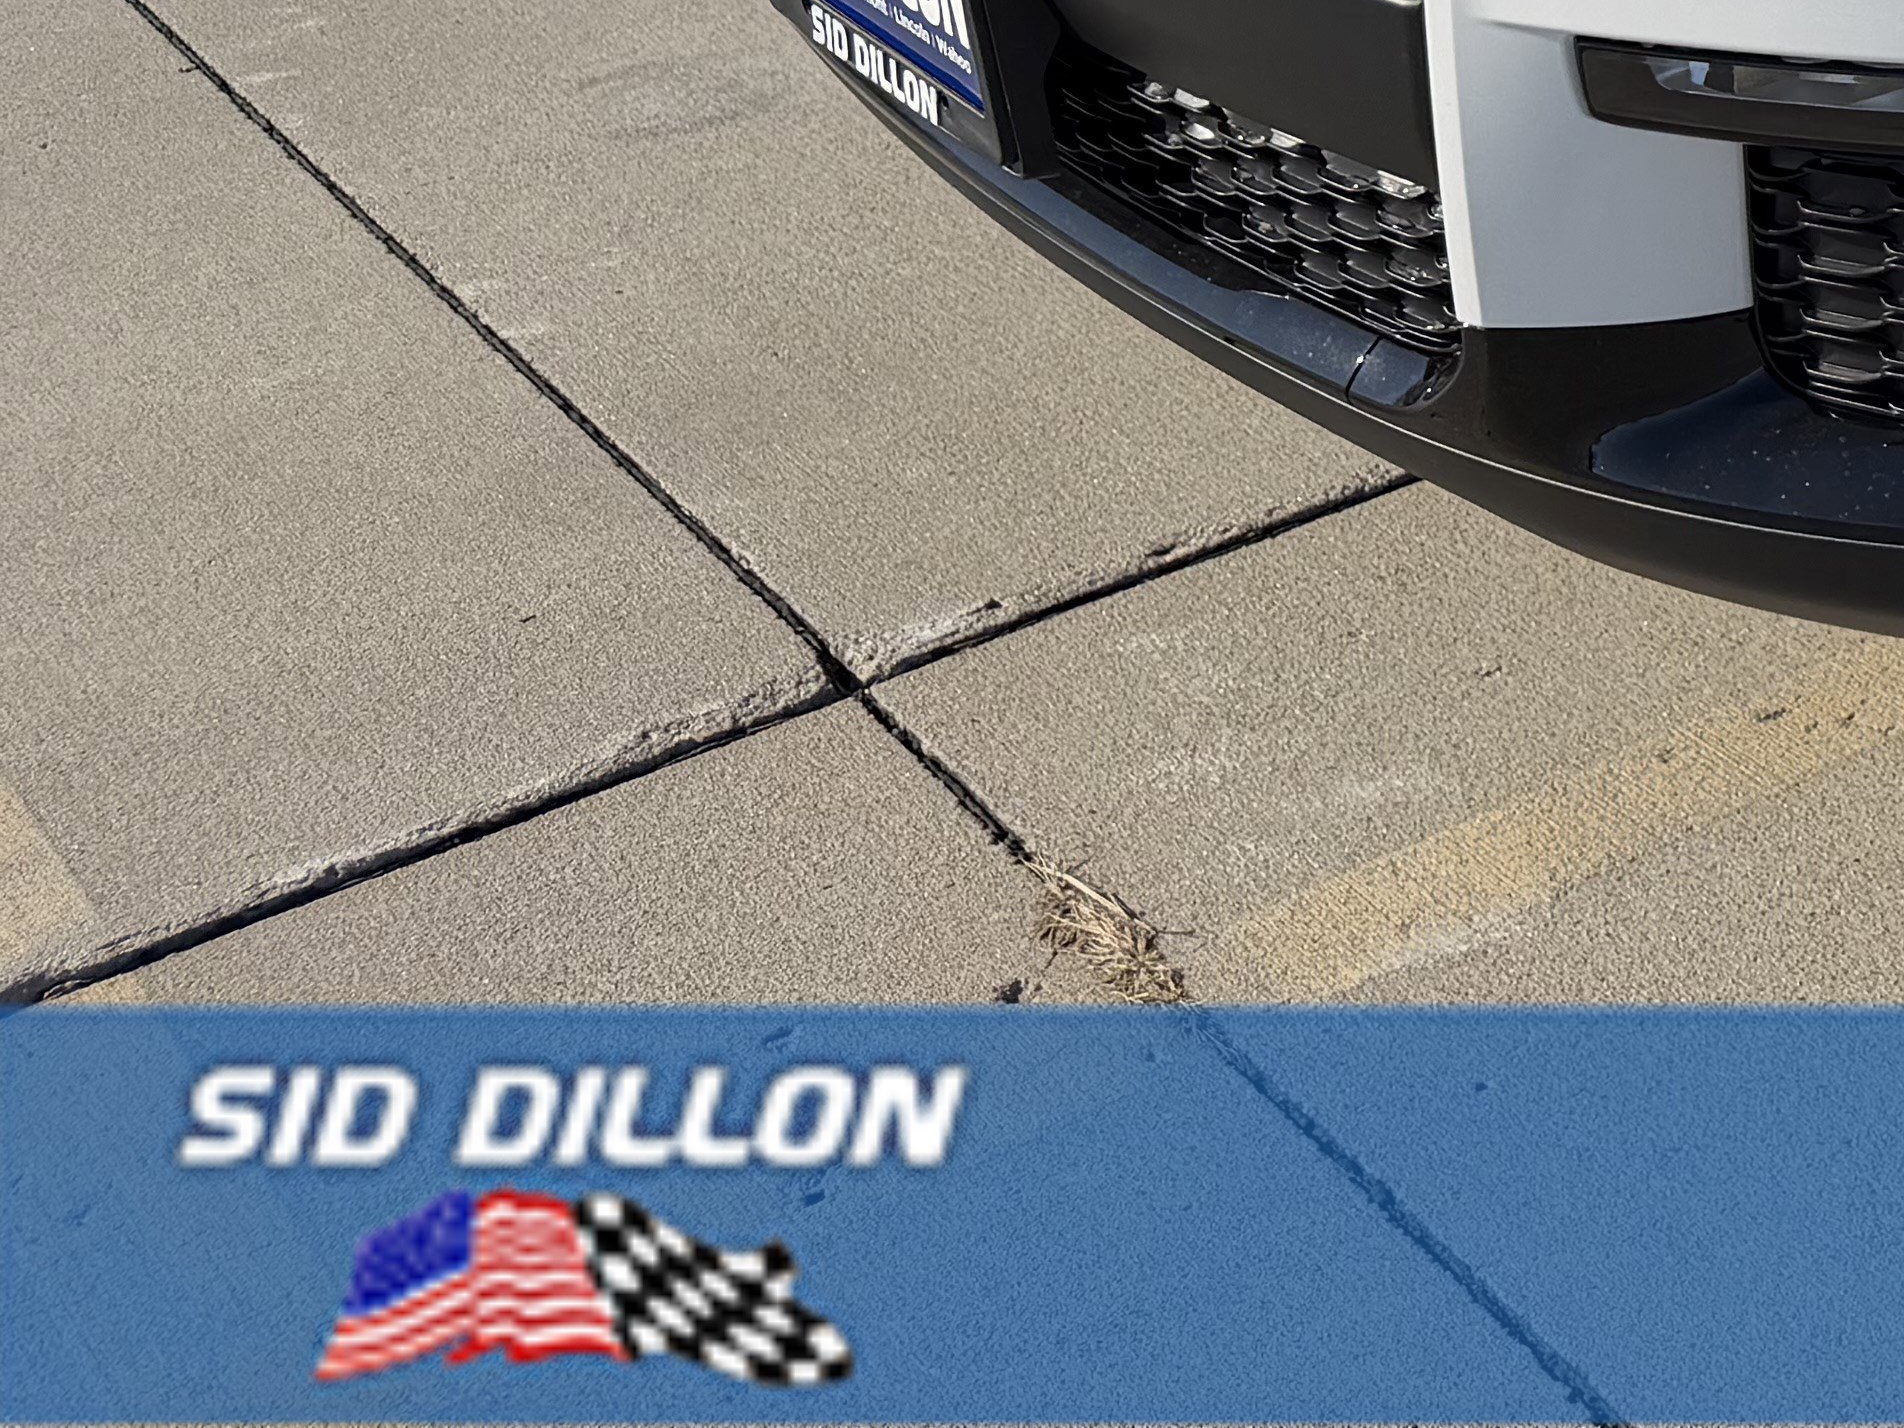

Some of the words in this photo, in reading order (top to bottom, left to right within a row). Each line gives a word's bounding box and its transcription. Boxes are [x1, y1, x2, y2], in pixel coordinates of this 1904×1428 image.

[810, 3, 849, 62] SID
[853, 32, 938, 126] DILLON
[893, 6, 931, 45] Lincoln
